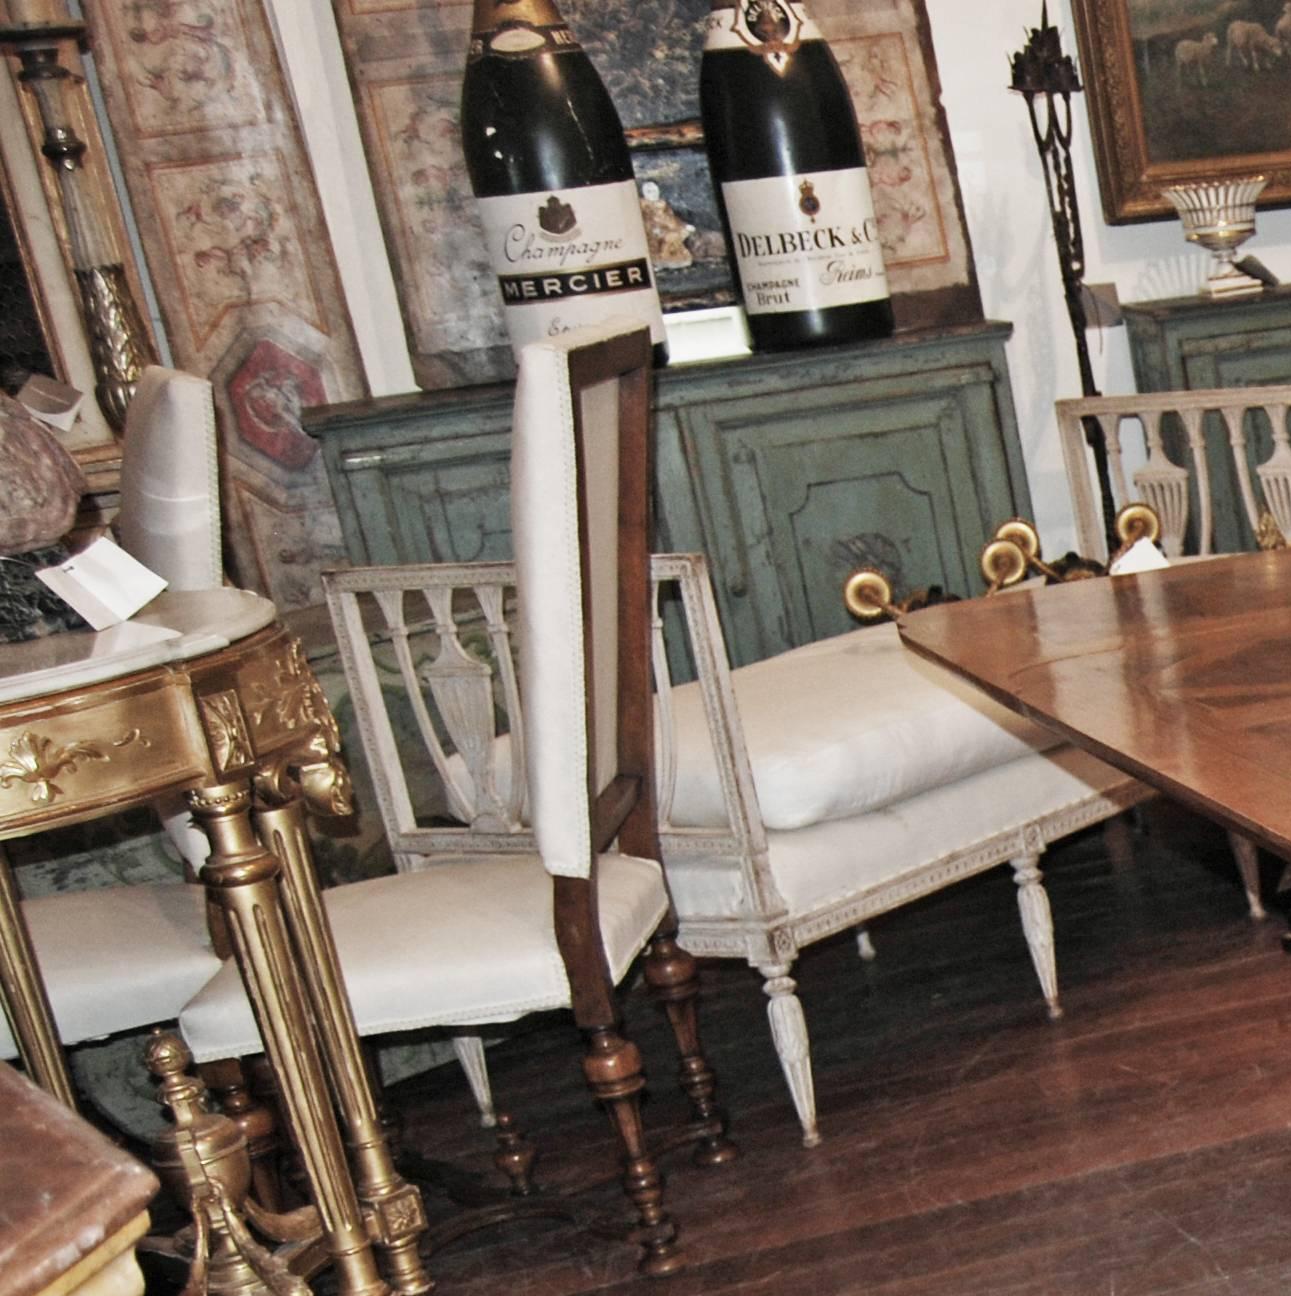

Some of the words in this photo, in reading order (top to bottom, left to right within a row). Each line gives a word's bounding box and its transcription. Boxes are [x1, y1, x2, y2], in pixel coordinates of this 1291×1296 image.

[504, 223, 623, 267] Champagne
[737, 227, 846, 259] DELBECK
[503, 267, 643, 298] MERCIER
[746, 278, 801, 291] CHAMPAGNE
[819, 260, 873, 286] Reims
[756, 290, 791, 306] Brut
